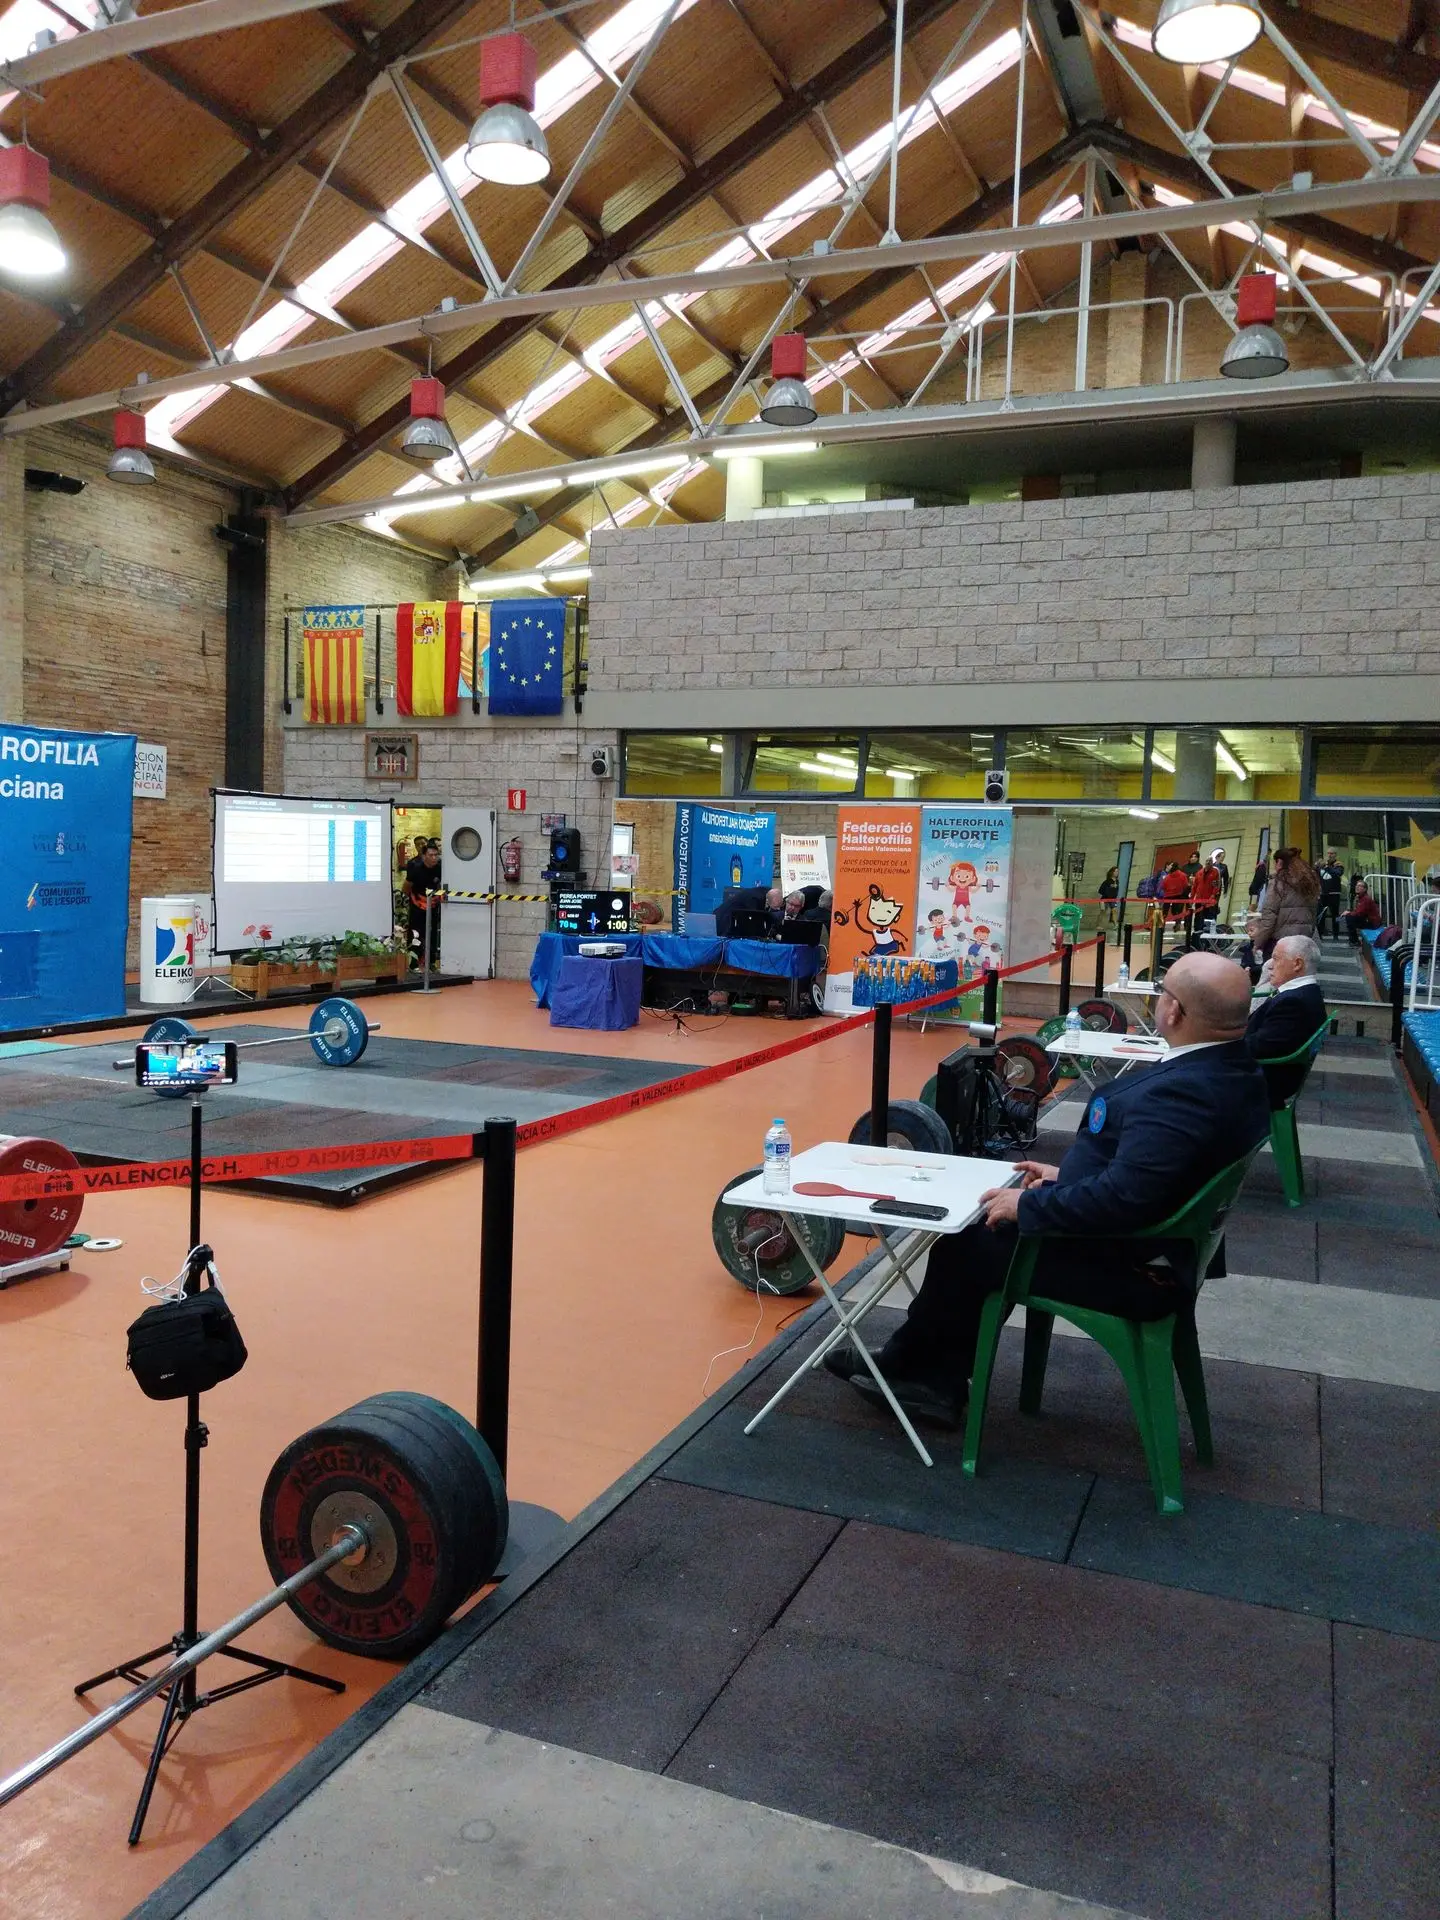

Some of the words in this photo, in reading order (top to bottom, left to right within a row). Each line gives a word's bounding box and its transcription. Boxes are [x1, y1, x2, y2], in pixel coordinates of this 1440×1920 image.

[0, 736, 99, 766] ROFILIA
[0, 775, 64, 800] ciana
[842, 821, 914, 834] Federació
[928, 818, 1005, 827] HALTEROFILIA
[841, 834, 912, 845] Halterofilia
[931, 829, 999, 841] DEPORTE
[38, 888, 85, 897] COMUNITAT
[42, 898, 55, 906] DE
[606, 920, 628, 930] 1:00
[155, 968, 193, 978] ELEIKO
[319, 1008, 329, 1019] 20
[340, 1006, 359, 1034] ELEIKO
[344, 1046, 352, 1057] 20
[642, 1085, 673, 1102] VALENCIA
[516, 1125, 538, 1144] NCIA
[23, 1159, 62, 1173] ELEIK
[84, 1165, 192, 1187] VALENCIA
[203, 1161, 243, 1177] C.H.
[50, 1207, 68, 1220] 2,5
[291, 1450, 402, 1494] SWEDEN
[312, 1594, 416, 1635] ELEIKO
